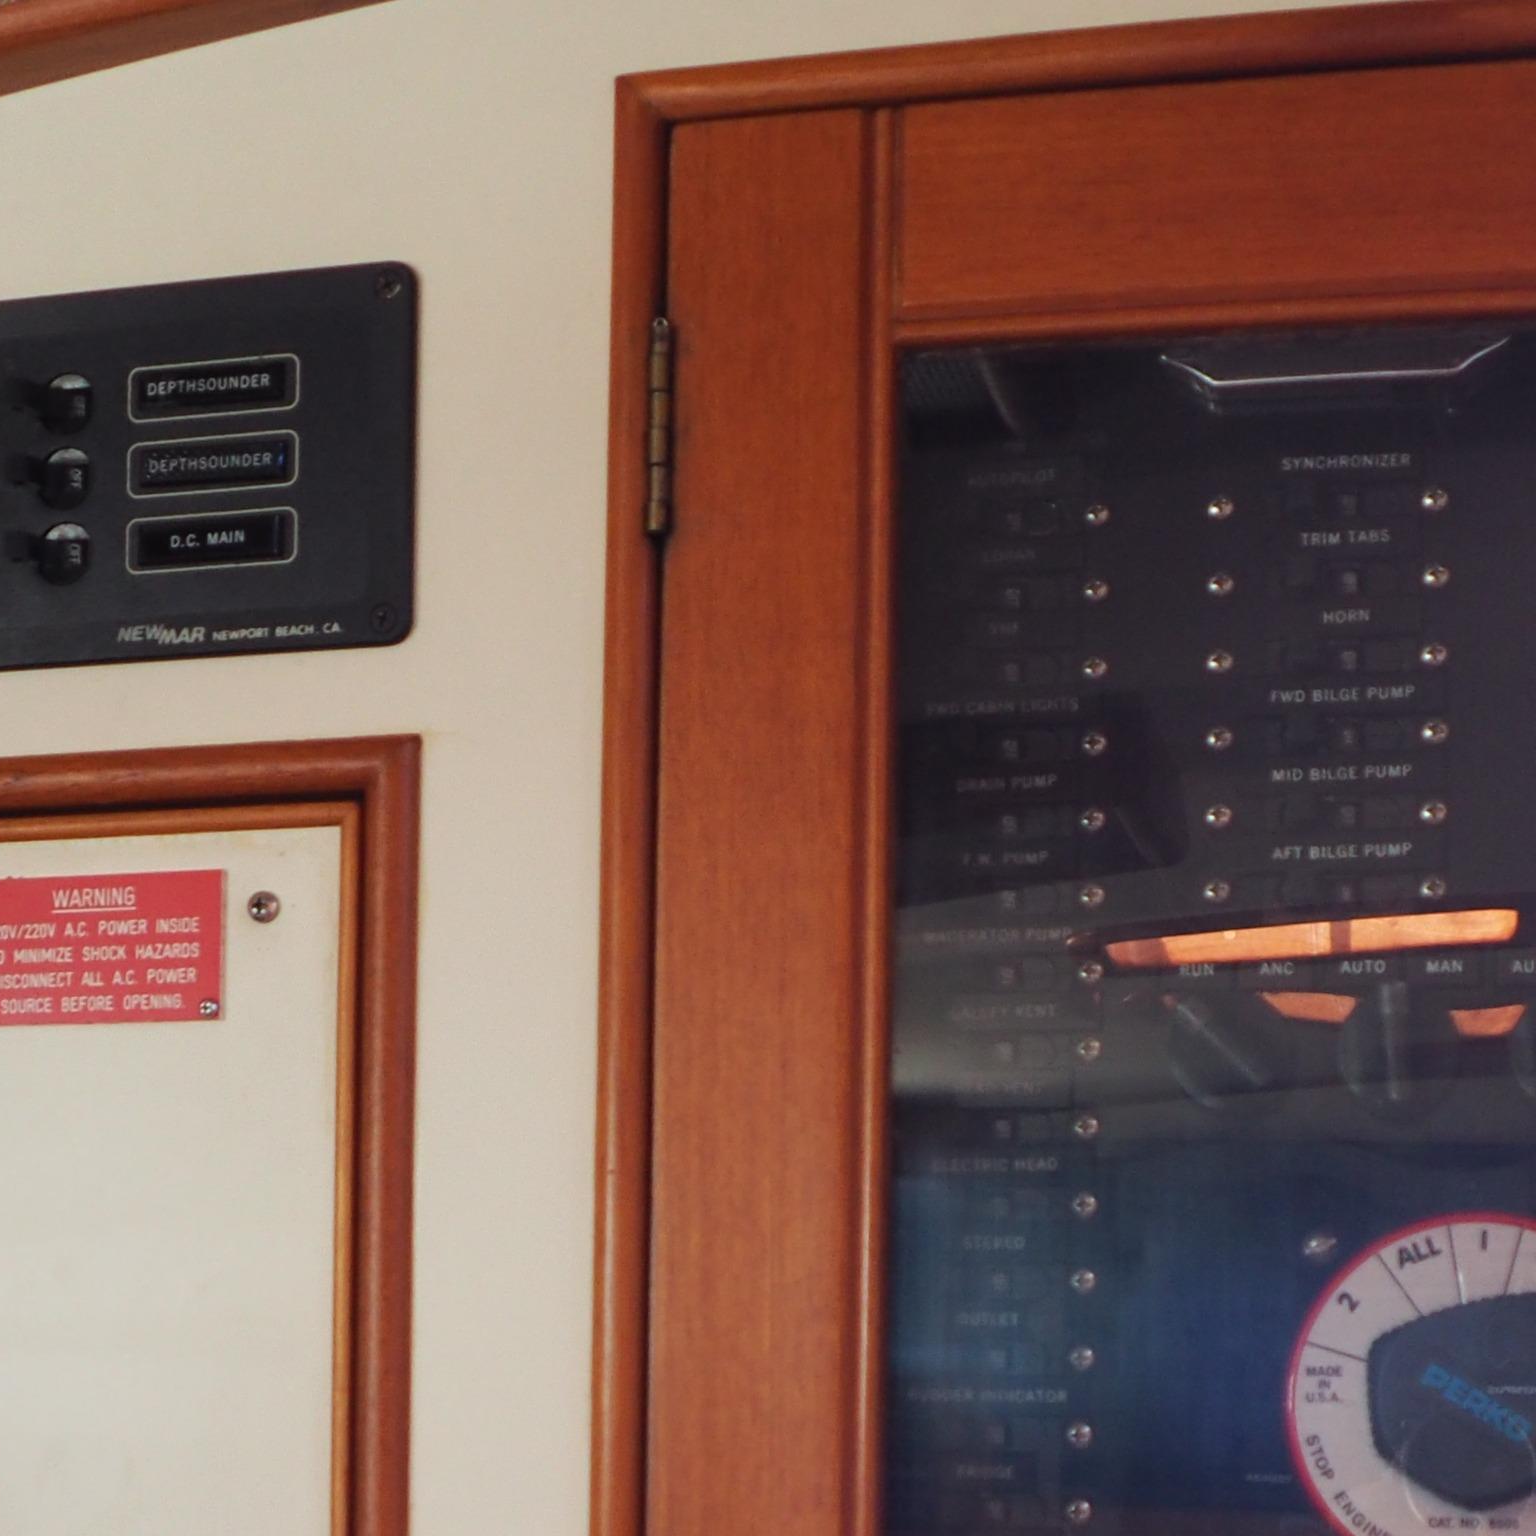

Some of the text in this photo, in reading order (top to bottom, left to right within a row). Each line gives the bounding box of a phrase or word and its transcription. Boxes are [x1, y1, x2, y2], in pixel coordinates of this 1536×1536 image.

[146, 372, 271, 397] DEPTHSOUNDER
[148, 451, 272, 474] DEPTHSOUNDER
[1280, 452, 1411, 472] SYNCHRONIZER
[169, 529, 245, 549] D.C. MAIN
[1300, 528, 1392, 547] TRIM TABS
[1322, 608, 1370, 624] HORN
[116, 624, 269, 646] NEWMAR NEWPORT
[1270, 684, 1416, 704] FWD BILGE PUMP
[1010, 773, 1058, 789] PUMP
[1271, 763, 1413, 782] MID BILGE PUMP
[1003, 849, 1050, 865] PUMP
[1272, 841, 1413, 860] AFT BILGE PUMP
[52, 886, 136, 908] WARNING
[98, 918, 147, 935] POWER
[156, 916, 200, 933] INSIDE
[13, 946, 72, 964] MINIMIZE
[82, 944, 126, 961] SHOCK
[135, 942, 200, 960] HAZARDS
[1260, 961, 1295, 976] ANC
[1340, 959, 1387, 974] AUTO
[1426, 958, 1463, 974] MAN
[81, 971, 104, 987] ALL
[146, 967, 197, 984] POWER
[0, 997, 52, 1014] SOURCE
[61, 994, 113, 1012] BEFORE
[1014, 1156, 1059, 1172] HEAD
[1396, 1236, 1442, 1270] ALL
[1337, 1292, 1360, 1314] 2
[1304, 1365, 1343, 1378] MADE
[1318, 1379, 1331, 1390] IN
[1419, 1361, 1534, 1443] PERKO
[1305, 1432, 1336, 1482] STOP
